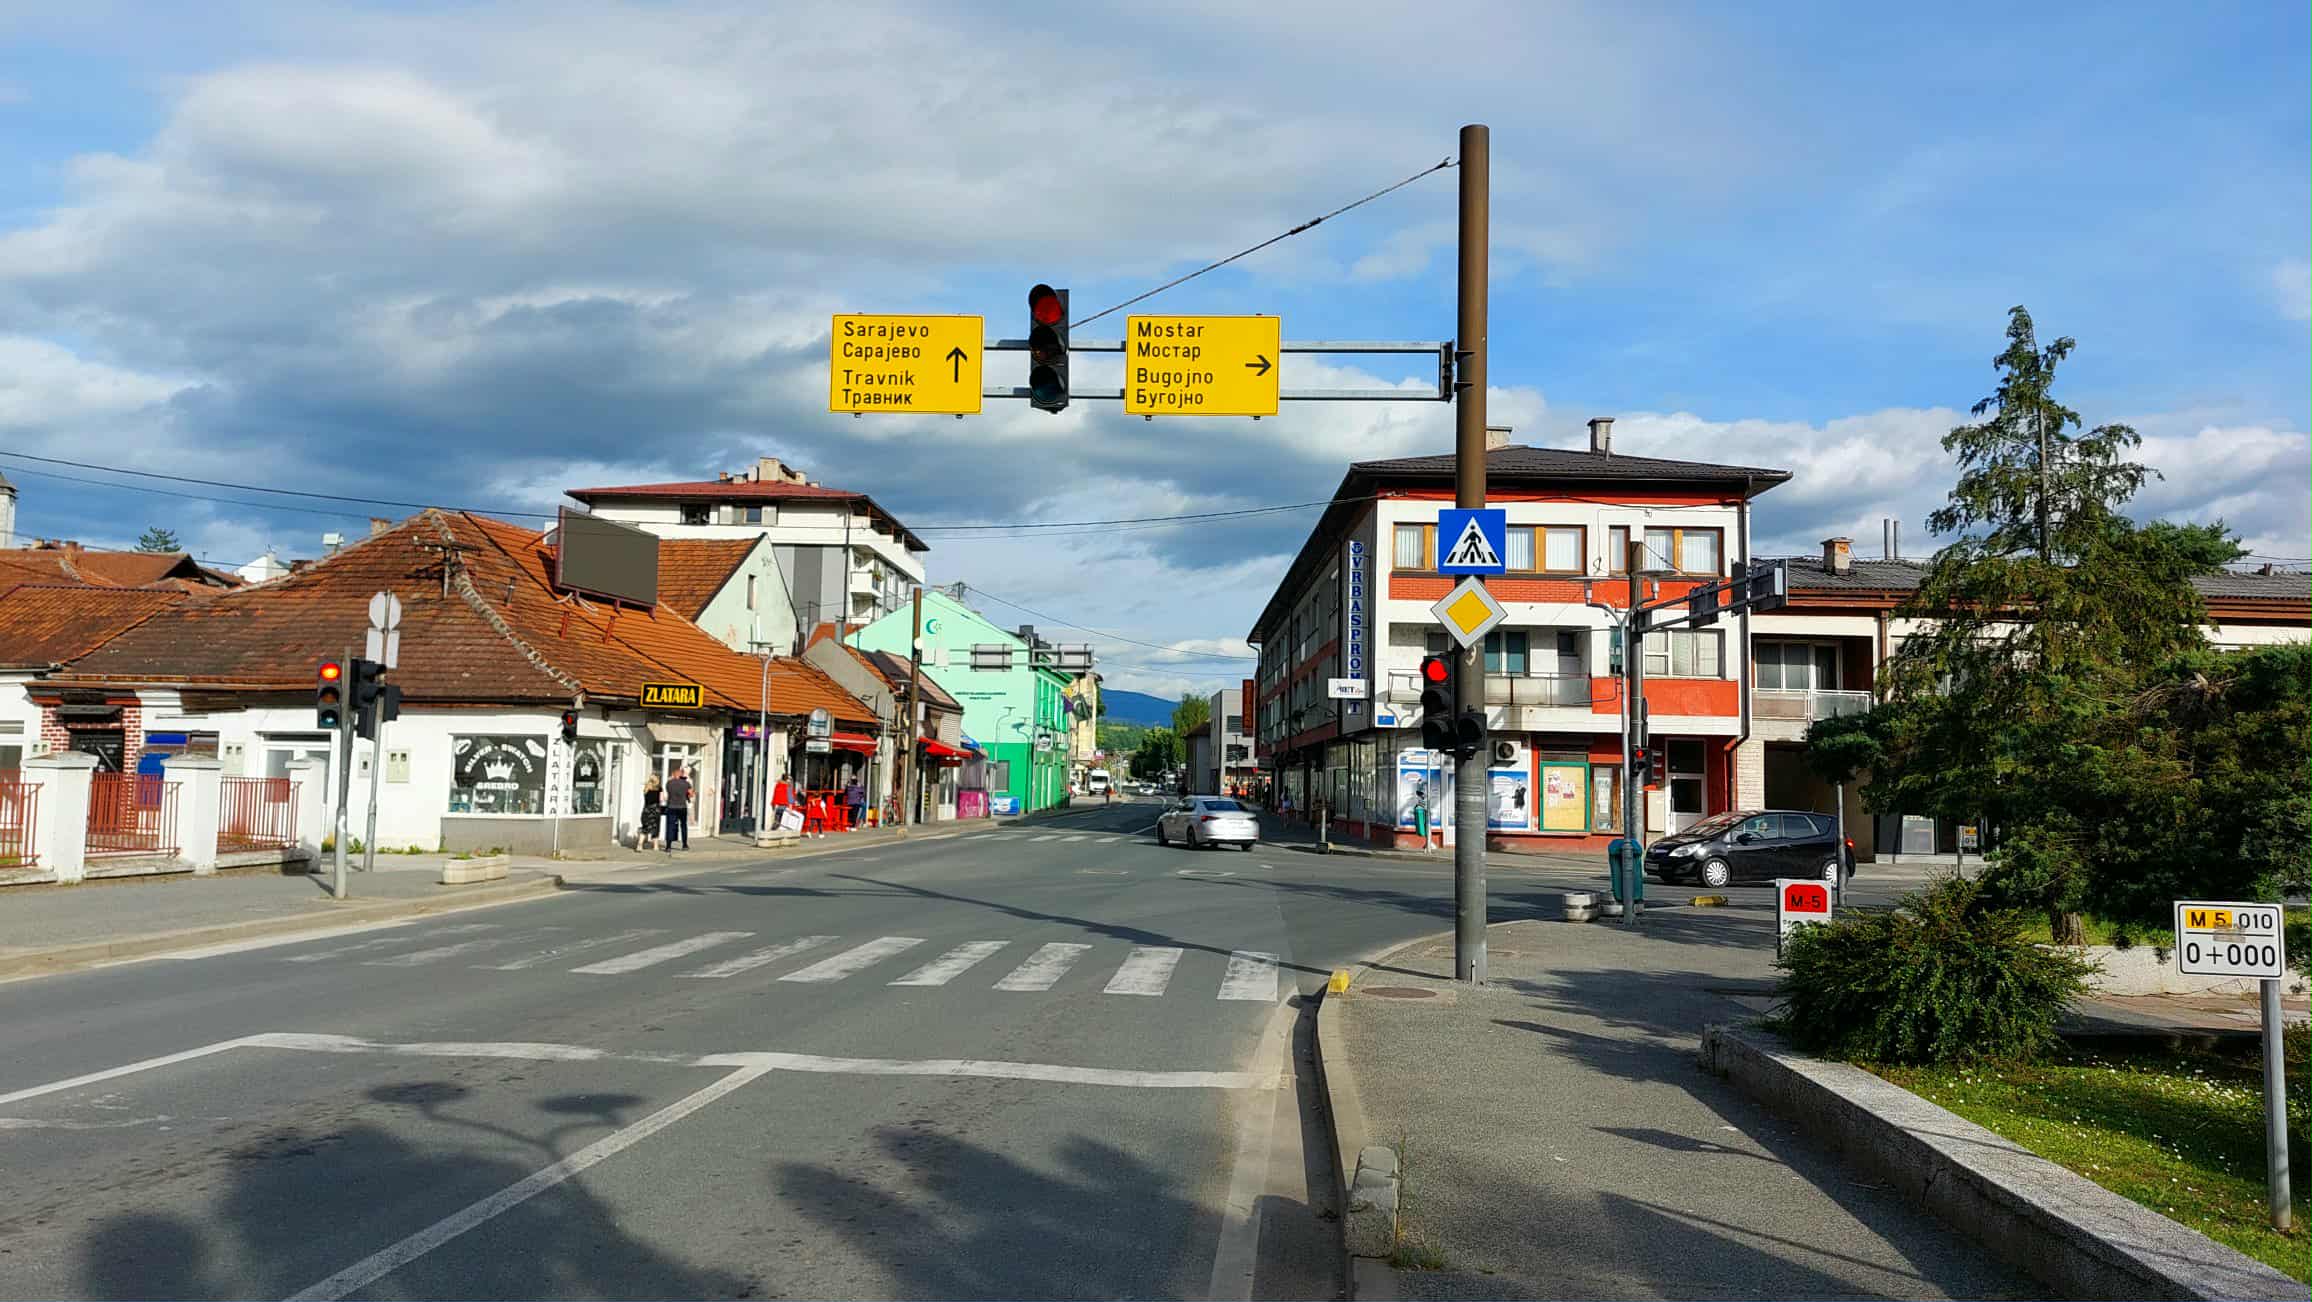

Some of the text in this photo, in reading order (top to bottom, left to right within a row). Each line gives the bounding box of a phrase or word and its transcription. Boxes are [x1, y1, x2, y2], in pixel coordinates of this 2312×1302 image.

[843, 321, 929, 342] Sarajevo
[1137, 321, 1205, 338] Mostar
[843, 341, 921, 362] Сарајево
[1137, 341, 1201, 362] Мостар
[842, 369, 916, 386] Travnik
[1136, 367, 1214, 388] Bugojno
[841, 388, 913, 409] Травник
[1136, 388, 1204, 409] Бугојно
[1350, 556, 1362, 713] VRBASPROMT
[645, 686, 696, 704] ZLATARA
[549, 737, 561, 815] ZLATARA
[1791, 894, 1821, 909] M-5
[2190, 911, 2273, 929] M 5 010
[2186, 942, 2275, 966] 0+000
